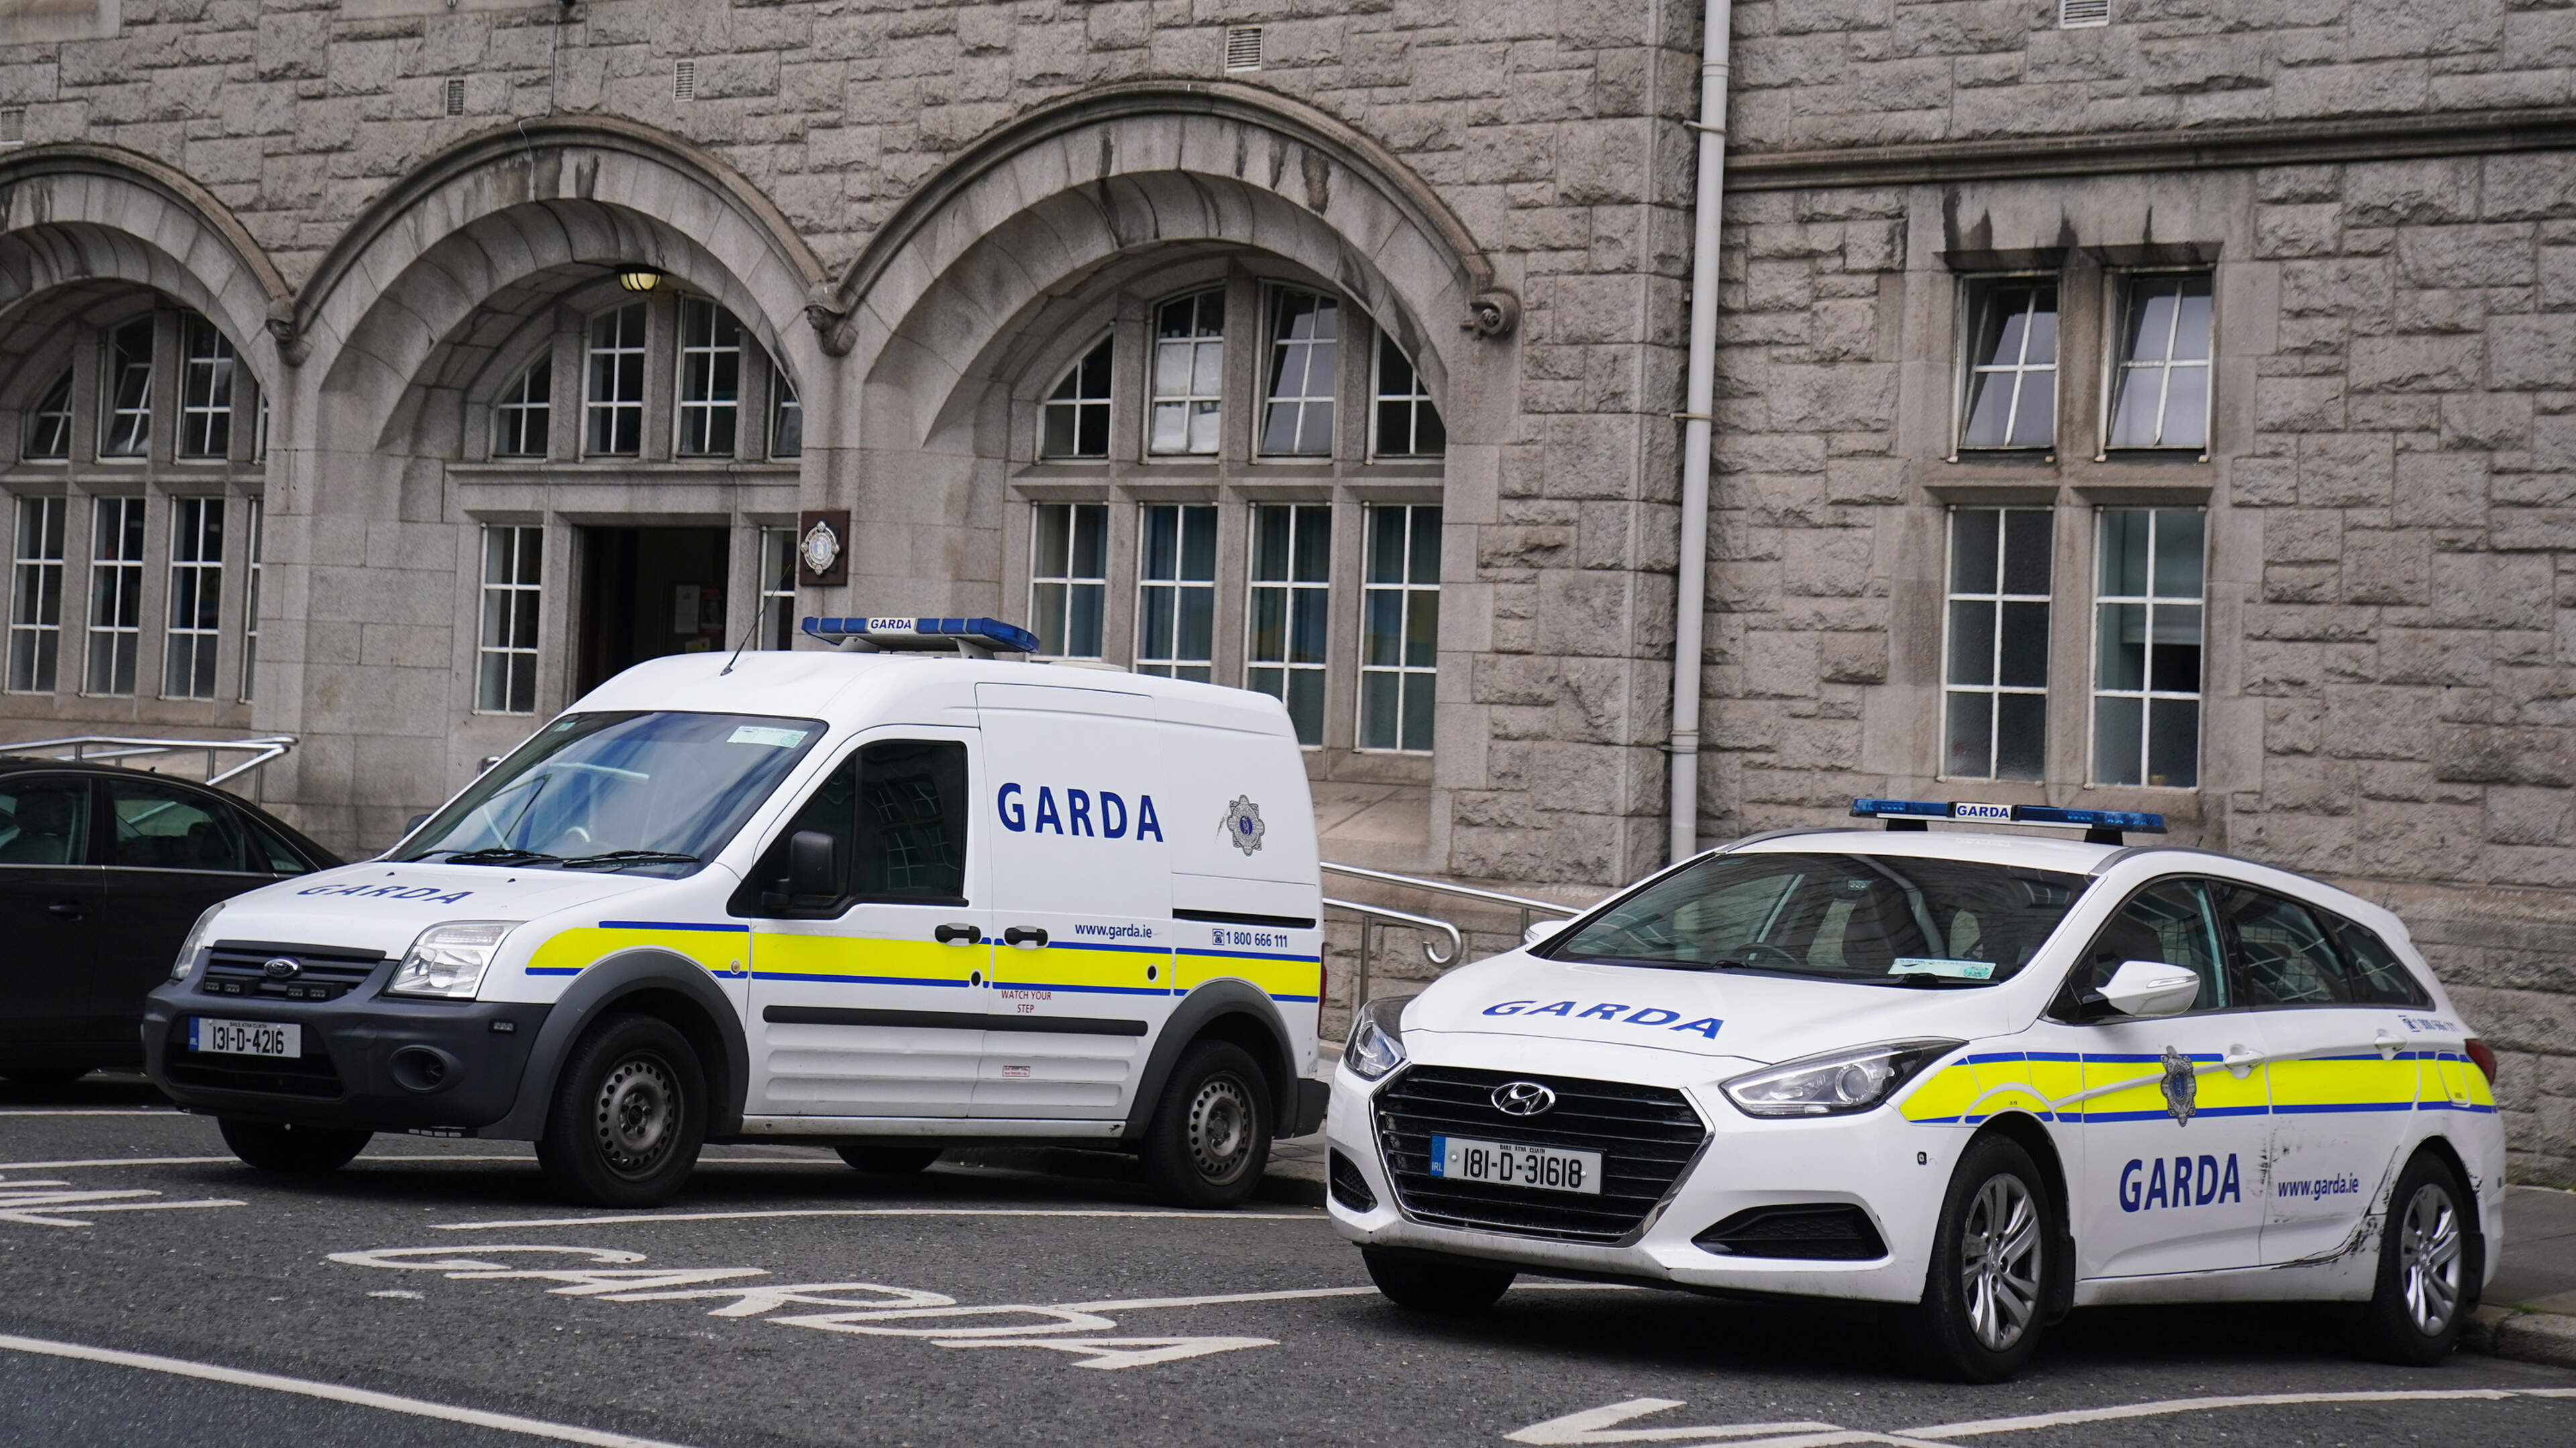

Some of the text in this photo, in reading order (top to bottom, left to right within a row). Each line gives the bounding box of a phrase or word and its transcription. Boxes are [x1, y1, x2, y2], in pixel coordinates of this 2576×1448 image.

[871, 619, 912, 629] GARDA
[997, 782, 1164, 842] GARDA
[1957, 805, 2009, 818] GARDA
[297, 884, 474, 904] GARDA
[1075, 923, 1152, 940] www.garda.ie
[1226, 931, 1287, 948] 1 800 666 111
[1001, 989, 1052, 1000] WATCH YOUR
[1017, 1003, 1034, 1013] STEP
[1482, 1001, 1724, 1040] GARDA
[213, 1026, 284, 1054] 131-D-4216
[1432, 1162, 1443, 1172] IRL
[1464, 1148, 1582, 1188] 181-D-31618
[2119, 1153, 2241, 1213] GARDA
[2278, 1173, 2359, 1201] www.garda.ie
